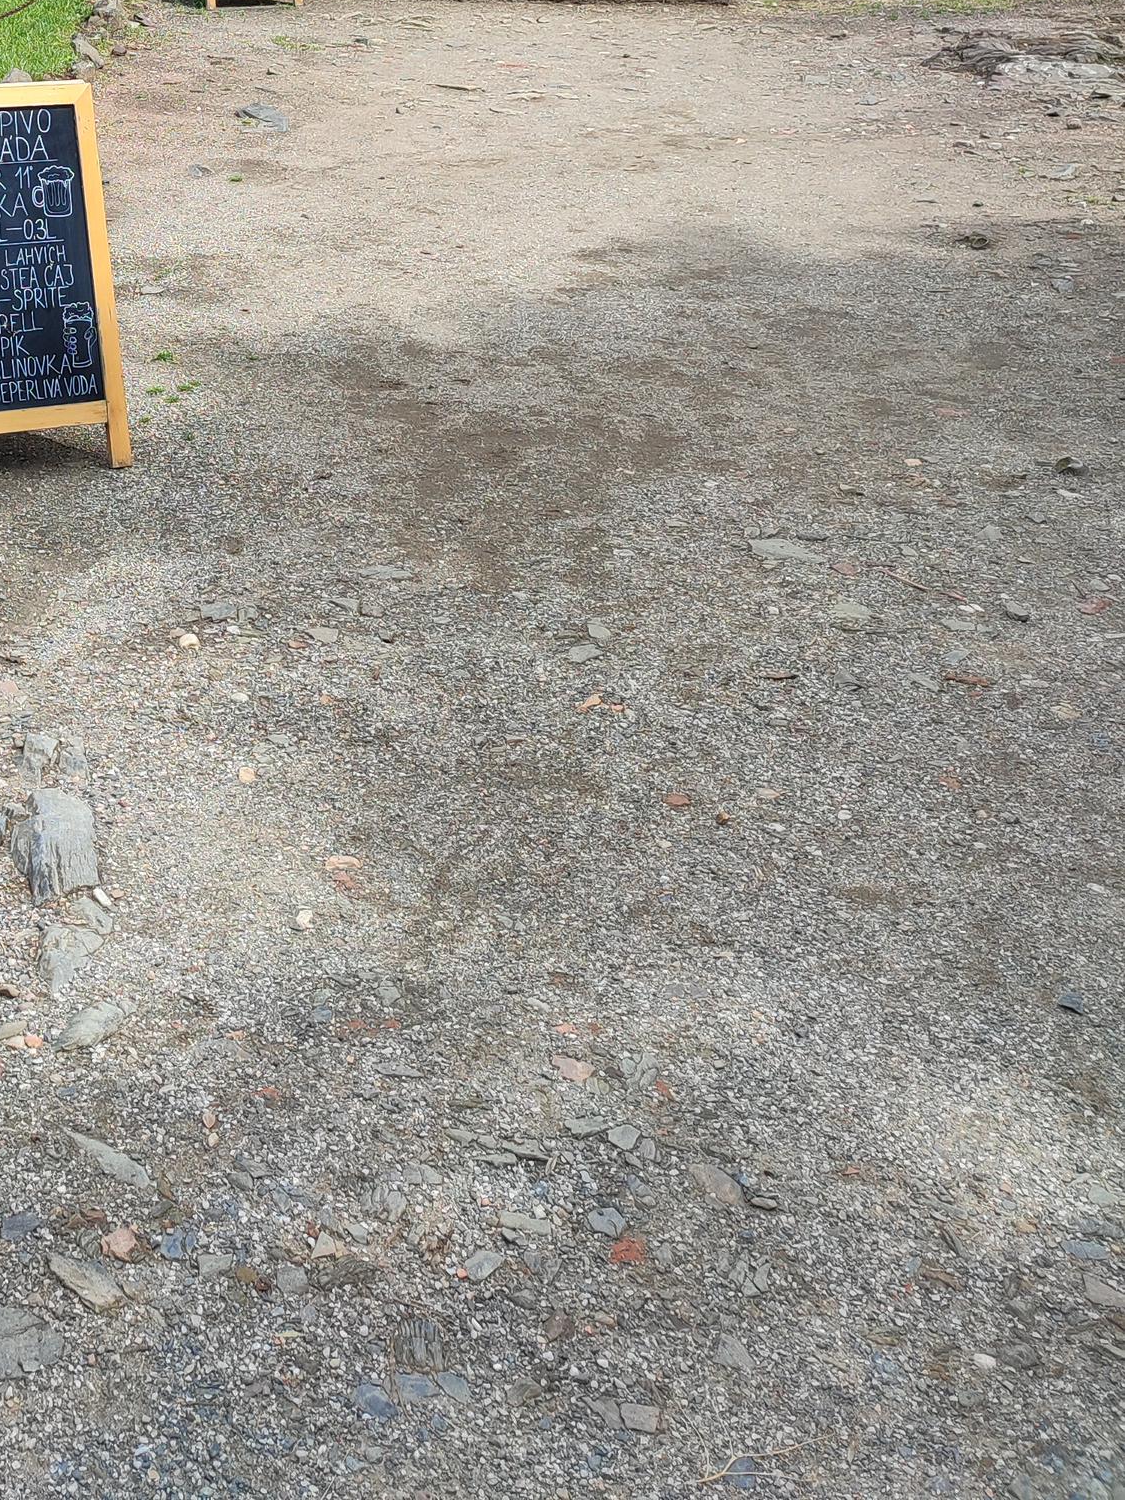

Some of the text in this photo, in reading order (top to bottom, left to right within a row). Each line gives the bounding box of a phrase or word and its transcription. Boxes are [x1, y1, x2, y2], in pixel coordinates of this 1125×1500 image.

[5, 244, 67, 267] LAHVÍCH
[44, 261, 75, 287] ČAJ
[64, 373, 98, 397] VODA
